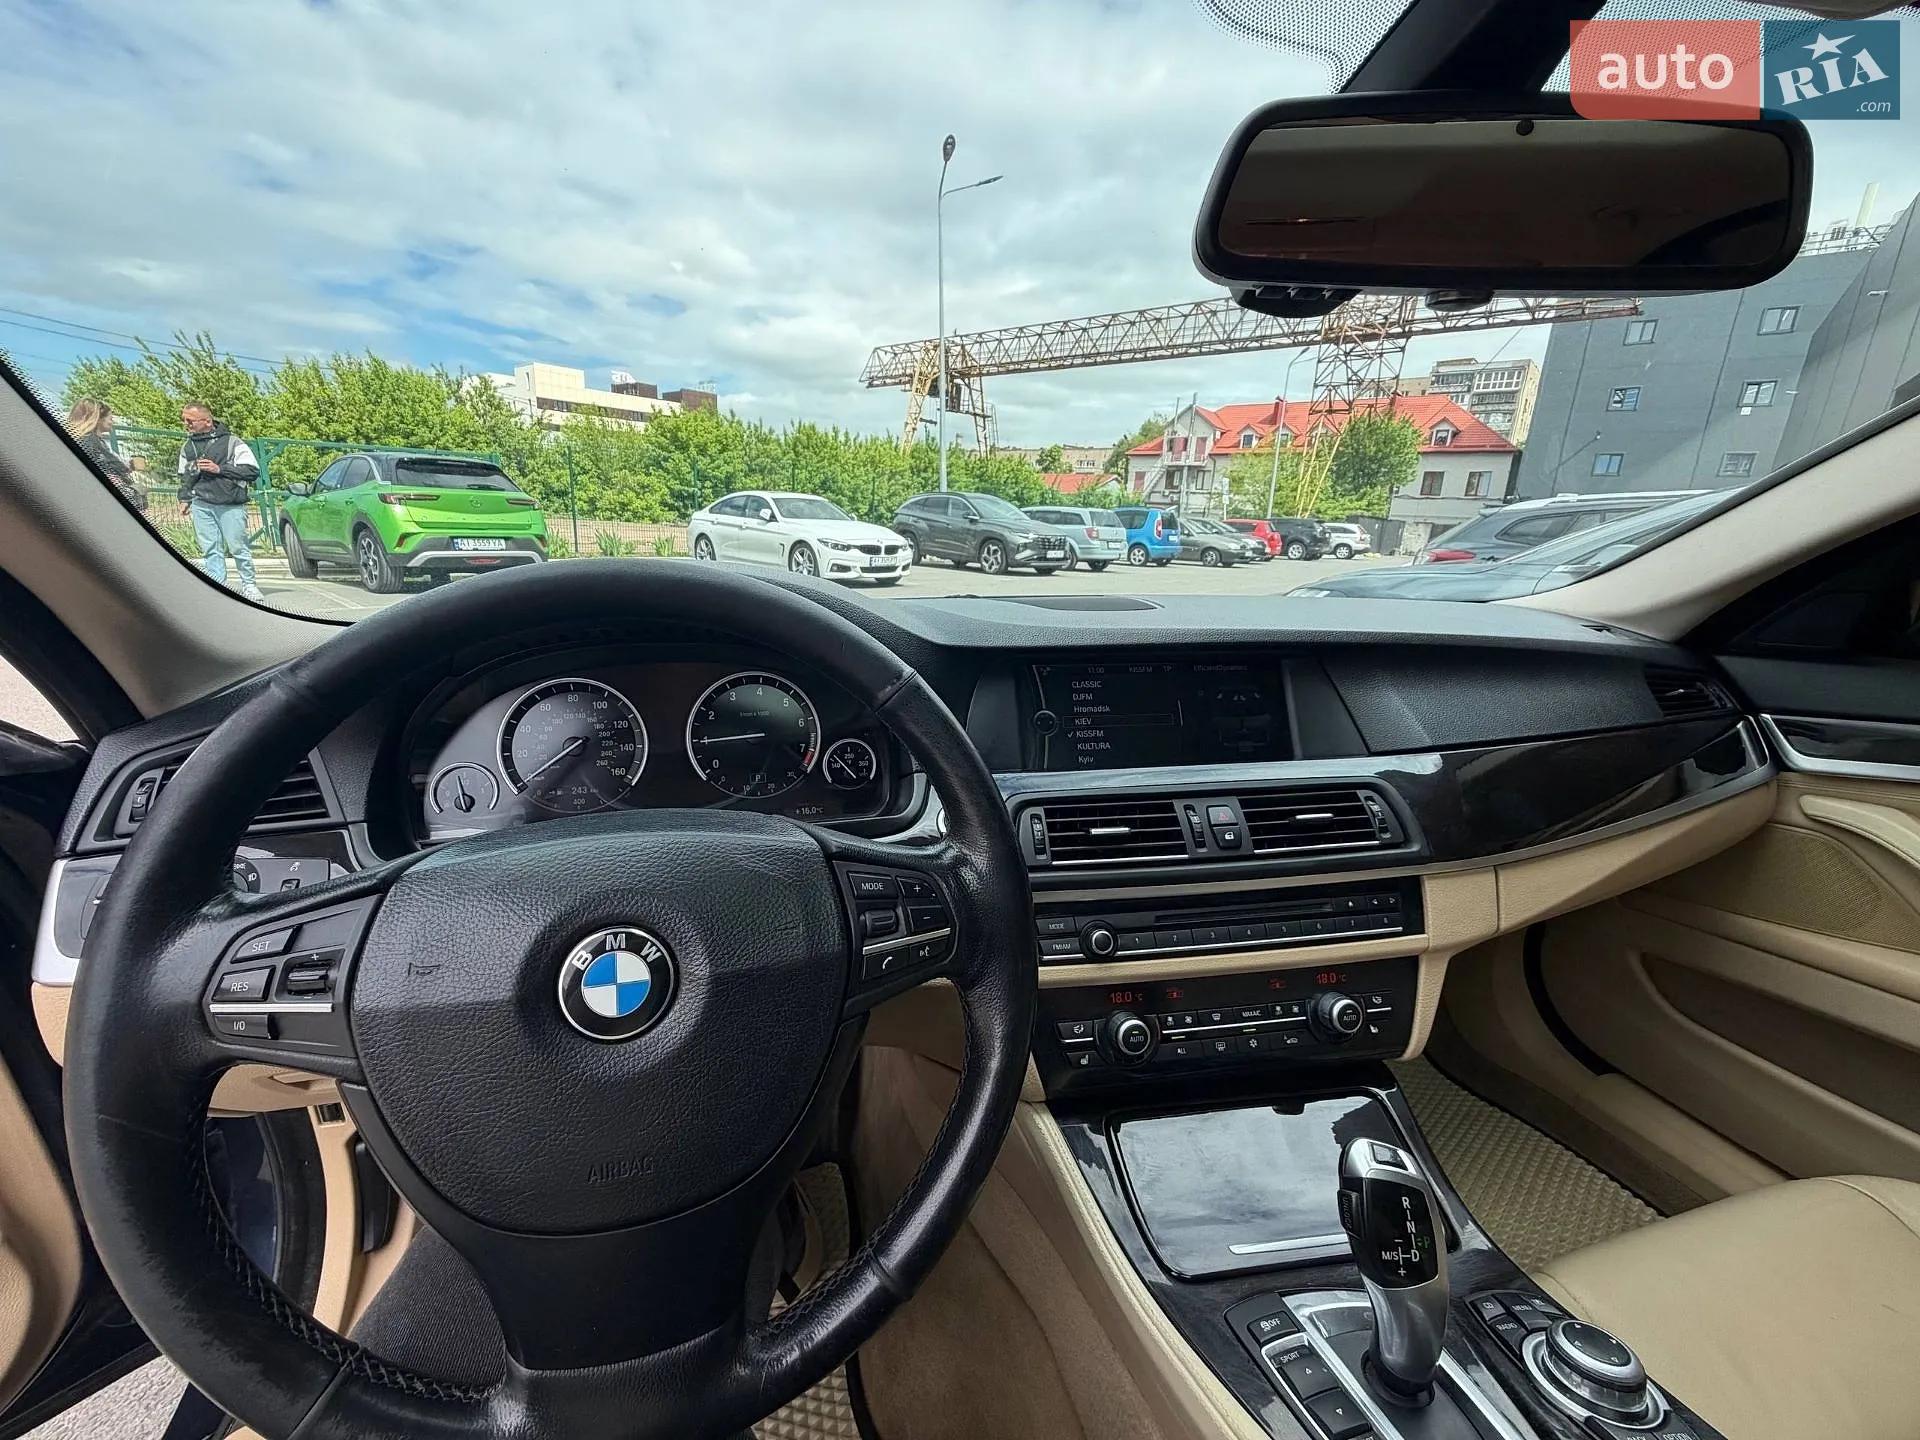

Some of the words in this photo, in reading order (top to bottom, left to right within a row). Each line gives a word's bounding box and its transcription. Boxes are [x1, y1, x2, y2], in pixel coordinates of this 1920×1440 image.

[1071, 680, 1102, 688] CLASSIC
[729, 692, 736, 700] 3
[756, 688, 762, 696] 4
[567, 694, 579, 702] 80
[783, 698, 789, 707] 5
[540, 703, 551, 712] 60
[592, 701, 608, 709] 100
[1073, 705, 1111, 713] Hromadsk
[708, 711, 715, 720] 2
[613, 720, 629, 729] 120
[798, 718, 805, 727] 6
[1075, 717, 1092, 725] KIEV
[520, 725, 531, 733] 40
[1076, 730, 1104, 738] KISSFM
[620, 743, 634, 751] 140
[800, 743, 805, 752] 7
[1077, 742, 1111, 750] KULTURA
[516, 750, 528, 758] 20
[712, 759, 719, 769] 0
[1078, 755, 1094, 764] Kyiv
[611, 767, 626, 776] 160
[571, 787, 587, 795] 243
[861, 882, 884, 890] MODE
[252, 941, 271, 952] SET
[572, 933, 662, 971] BMW
[230, 982, 249, 992] RES
[233, 1021, 246, 1031] I/O
[1129, 1035, 1144, 1043] AUTO
[1176, 1047, 1187, 1055] ALL
[587, 1157, 653, 1184] AIRBAG
[1401, 1196, 1411, 1209] R
[1406, 1220, 1416, 1233] N
[1381, 1250, 1399, 1261] M/S
[1411, 1249, 1420, 1262] D
[1483, 1301, 1494, 1309] CD
[1268, 1317, 1281, 1328] OFF
[1496, 1322, 1518, 1331] RADIO
[1280, 1351, 1300, 1364] SPORT
